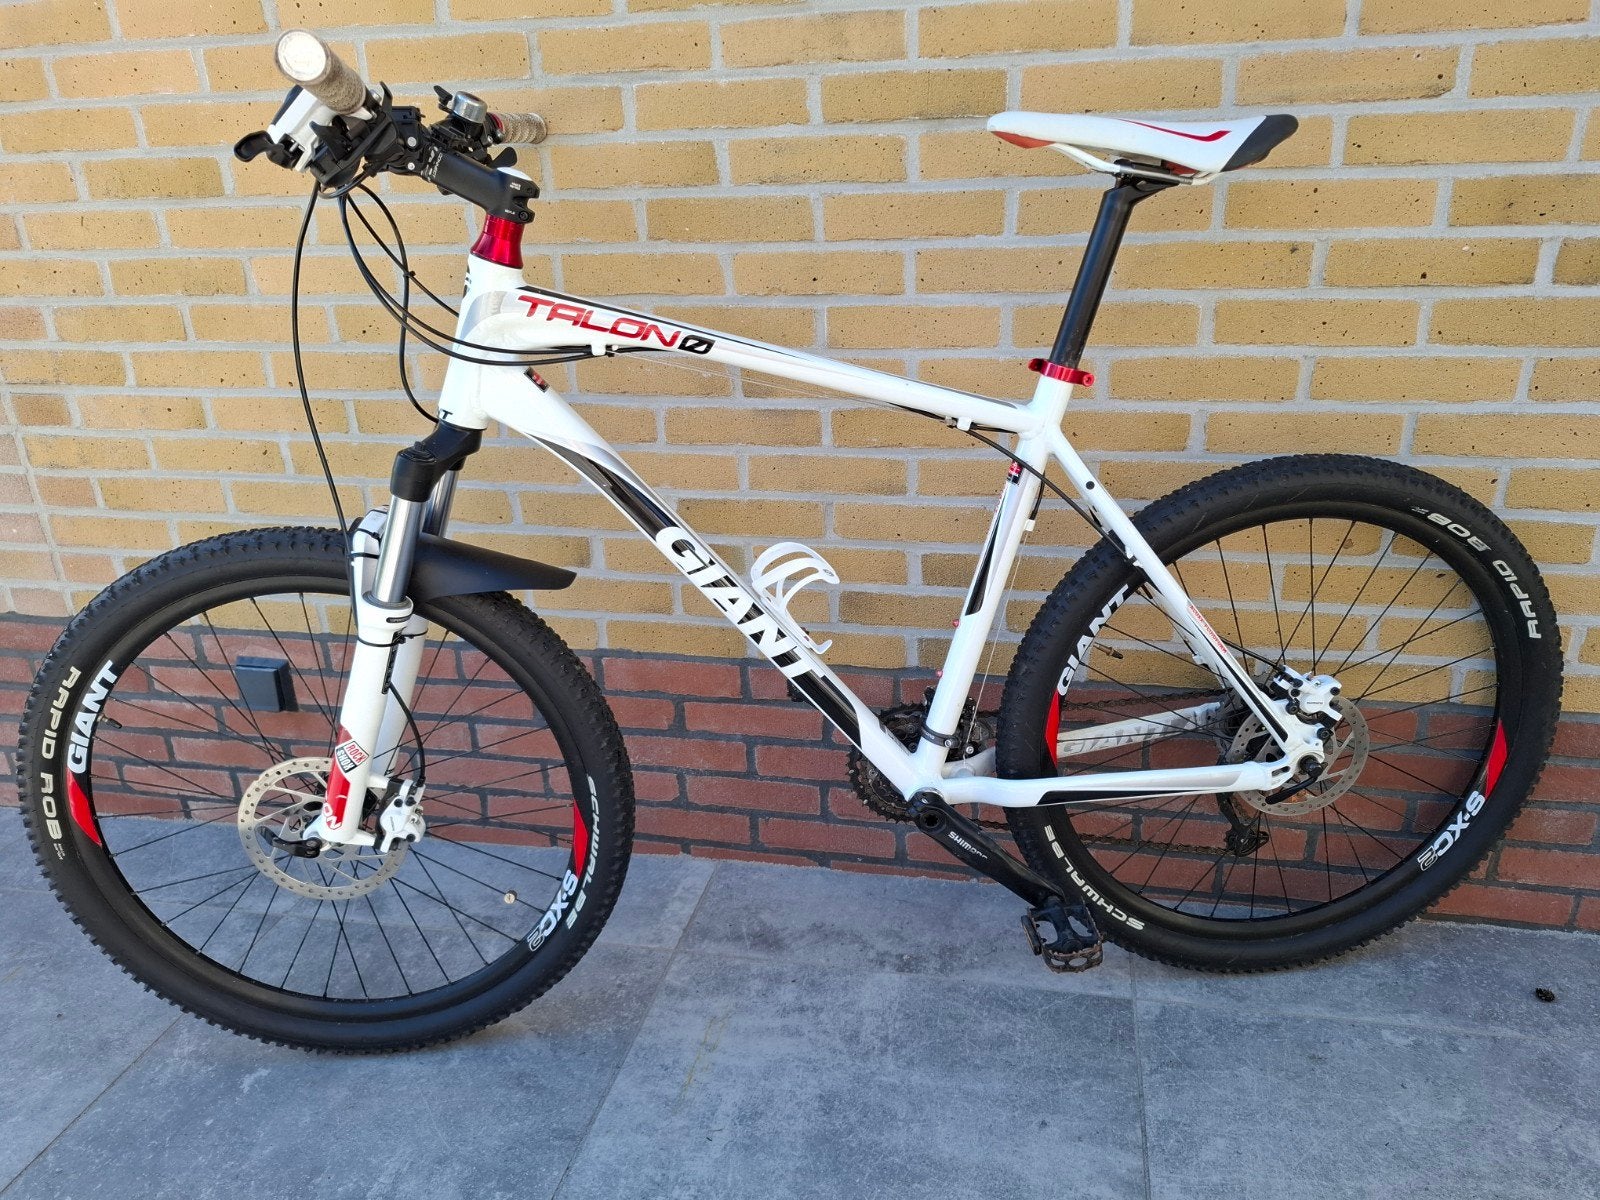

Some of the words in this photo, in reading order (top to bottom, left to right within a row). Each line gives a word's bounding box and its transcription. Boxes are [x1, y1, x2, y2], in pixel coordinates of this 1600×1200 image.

[518, 295, 682, 347] TALON
[1426, 512, 1492, 552] ROB
[655, 527, 826, 679] GIANT
[1056, 583, 1129, 697] GIANT
[1492, 559, 1542, 639] RAPID
[41, 665, 82, 760] RAPID
[66, 659, 119, 774] GIANT
[345, 743, 367, 765] ROCK
[336, 748, 355, 771] SHOX
[40, 772, 63, 840] ROB
[565, 774, 600, 930] SCHWALBE
[1044, 824, 1145, 931] SCHWALBE
